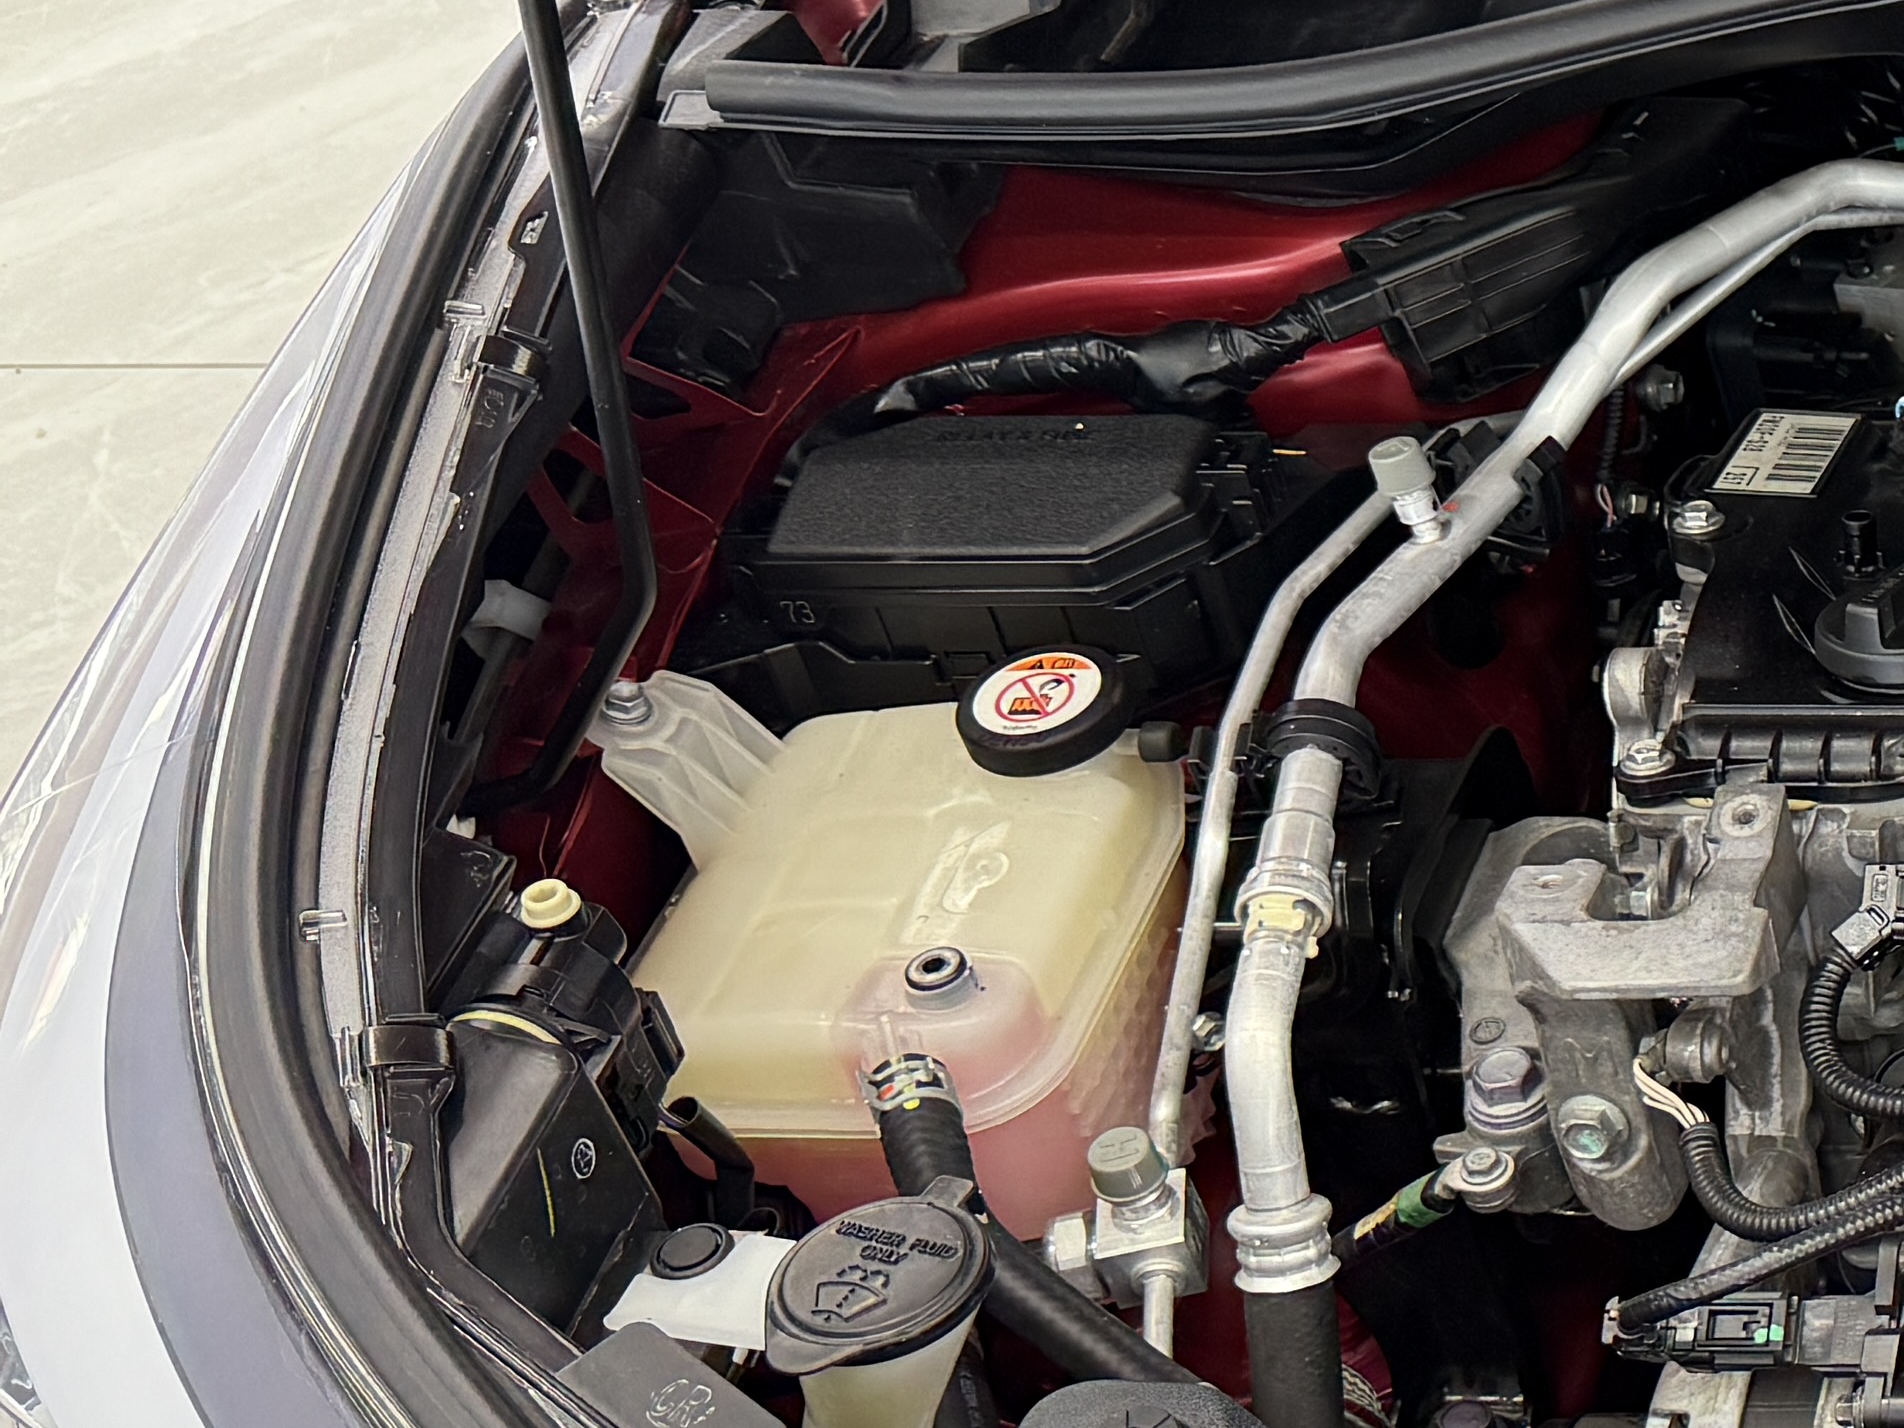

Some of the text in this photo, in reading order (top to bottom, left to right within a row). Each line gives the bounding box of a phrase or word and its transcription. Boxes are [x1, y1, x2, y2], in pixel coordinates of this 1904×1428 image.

[779, 600, 816, 624] 73
[835, 1220, 960, 1260] WASHER FLUID
[859, 1244, 909, 1266] ONLY
